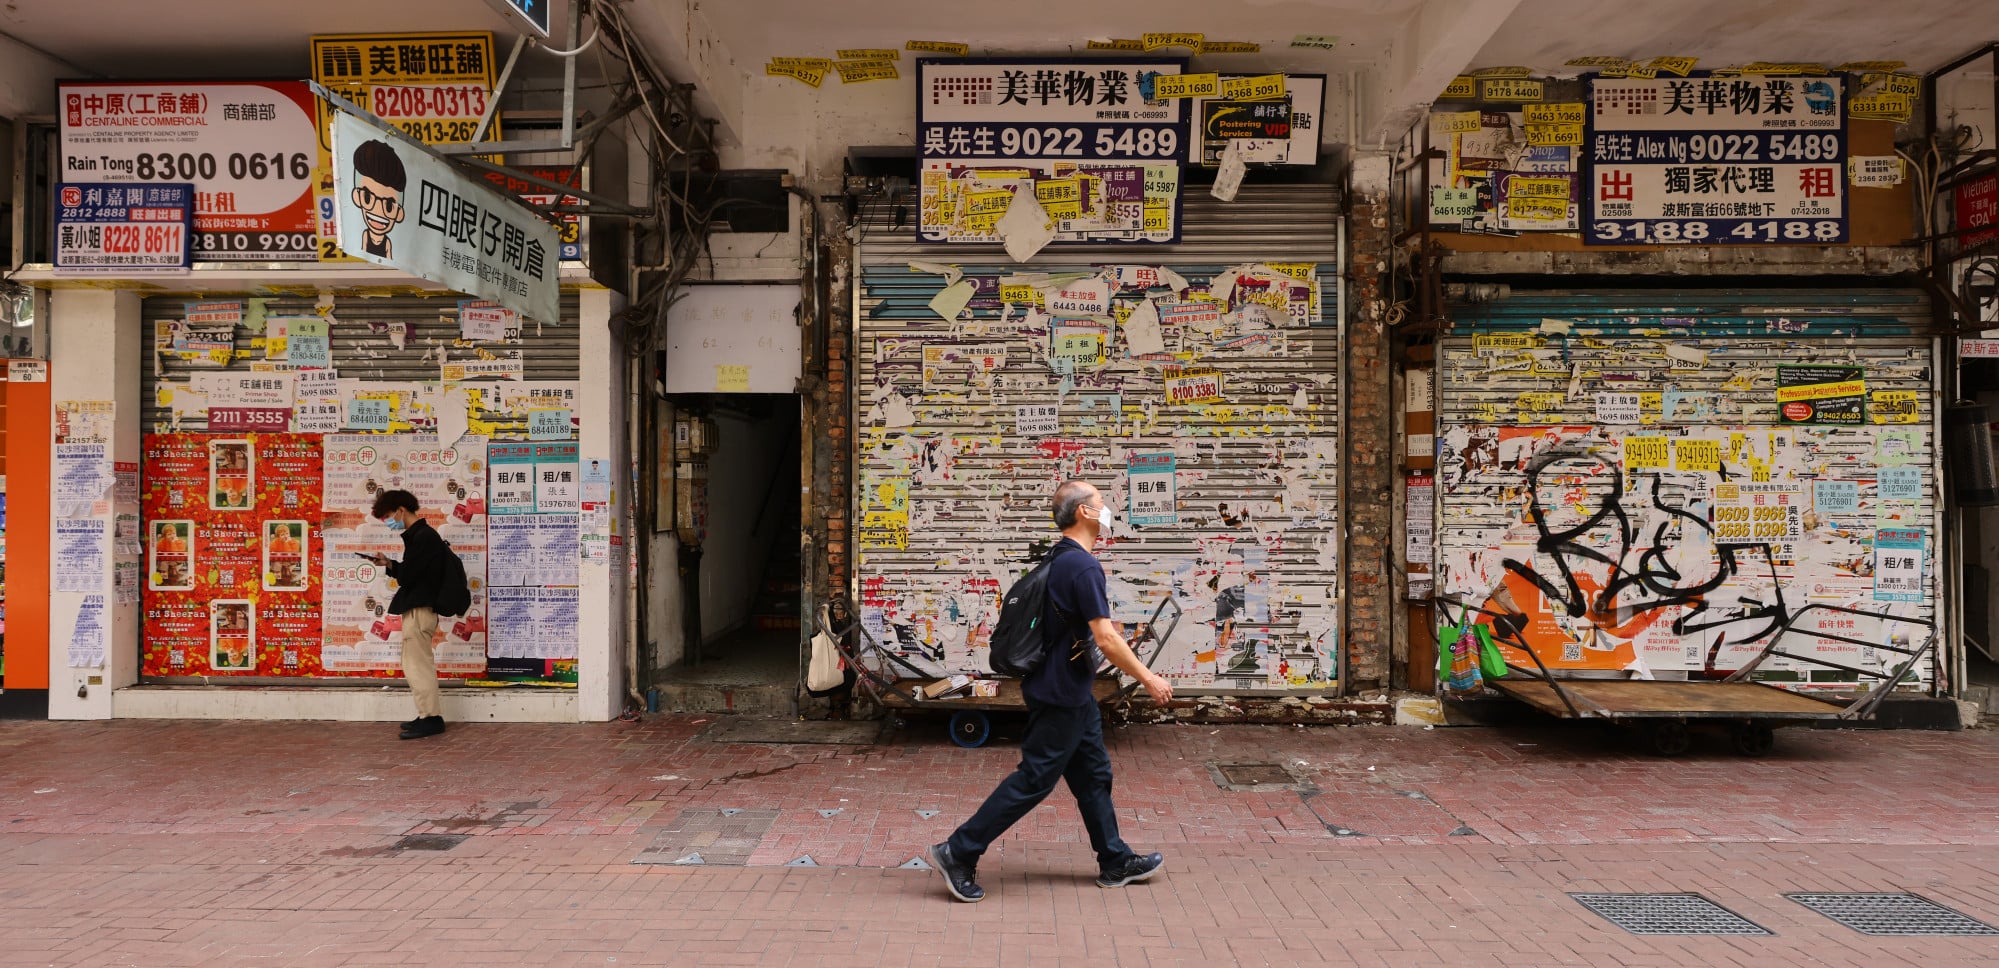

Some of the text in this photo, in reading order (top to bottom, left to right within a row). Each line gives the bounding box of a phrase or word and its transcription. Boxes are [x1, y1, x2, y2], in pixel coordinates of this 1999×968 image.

[1147, 36, 1198, 48] 9178 4400
[368, 43, 484, 76] 美聯旺舖
[797, 70, 819, 85] 6317
[996, 69, 1130, 108] 美華物業
[1159, 82, 1214, 96] 9320 1680
[1227, 84, 1280, 99] 9368 5091
[1487, 87, 1539, 98] 9178 4400
[1890, 83, 1916, 95] 0624
[374, 85, 486, 118] 8208-0313
[1662, 79, 1796, 116] 美華物業
[223, 103, 276, 122] 商舖部
[1810, 101, 1837, 117] 旺舖
[1853, 101, 1902, 113] 6333 8171
[1096, 110, 1168, 120] 牌照號碼 C-069993
[1530, 112, 1555, 122] 9463
[85, 116, 208, 127] CENTALINE COMMERCIAL
[1452, 119, 1478, 130] 8316
[1762, 119, 1835, 128] 牌照號碼 C-069993
[1219, 120, 1290, 136] Postering VIP
[1219, 130, 1253, 138] Services
[923, 126, 1178, 156] 吳先生 9022 5489
[1555, 132, 1578, 143] 6691
[1594, 134, 1839, 163] 吳先生 Alex Ng 9022 5489
[68, 152, 309, 182] Rain Tong 8300 0616
[1156, 181, 1175, 194] 5987
[1600, 166, 1836, 202] 出 獨家代理 租
[1962, 177, 1997, 199] Vietnam
[84, 187, 144, 207] 利嘉閣
[193, 191, 237, 214] 出租
[62, 207, 92, 219] 2812
[95, 207, 127, 219] 4888
[132, 208, 183, 222] 旺舖出租
[1456, 205, 1476, 217] 5987
[1601, 202, 1830, 218] 025098 波斯富街66號地下 07-12-2018
[1969, 211, 1990, 228] SPA
[419, 178, 546, 283] 四眼仔開倉
[1594, 221, 1842, 242] 3188 4188
[61, 225, 181, 254] 黃小姐 8228 8611
[191, 234, 318, 252] 2810 9900
[1004, 290, 1030, 300] 9463
[1060, 290, 1097, 301] 業主放盤
[1053, 302, 1103, 314] 6443 0486
[290, 351, 326, 361] 6180-8416
[1078, 353, 1098, 364] 5987
[23, 373, 31, 381] 60
[239, 379, 283, 391] 旺舖租售
[1838, 384, 1862, 393] Services
[263, 391, 279, 400] Shop
[300, 387, 338, 397] 3695 0883
[1171, 383, 1217, 400] 8100 3383
[212, 411, 284, 425] 2111 3555
[1018, 407, 1057, 417] 業主放盤
[1598, 411, 1639, 422] 3695 0883
[1823, 412, 1841, 420] 9402
[350, 415, 389, 425] 68440189
[300, 422, 338, 431] 3695 0883
[531, 424, 570, 435] 68440189
[1018, 424, 1057, 433] 3695 0883
[149, 450, 206, 458] Ed Sheeran
[263, 450, 320, 458] Ed Sheeran
[1625, 443, 1668, 461] 93419313
[1676, 446, 1720, 464] 93419313
[498, 471, 526, 484] 租/售
[543, 470, 572, 484] 租/售
[1137, 481, 1167, 493] 租/售
[1882, 484, 1917, 493] 51276901
[539, 499, 577, 509] 51976780
[1753, 494, 1789, 506] 租 售
[1819, 497, 1853, 506] 51276901
[1715, 505, 1800, 536] 9609 9966 吳先生
[199, 530, 256, 538] Ed Sheeran
[1715, 522, 1788, 538] 3686 0396
[1884, 556, 1915, 570] 租/售
[149, 610, 206, 618] Ed Sheeran
[262, 610, 319, 618] Ed Sheeran
